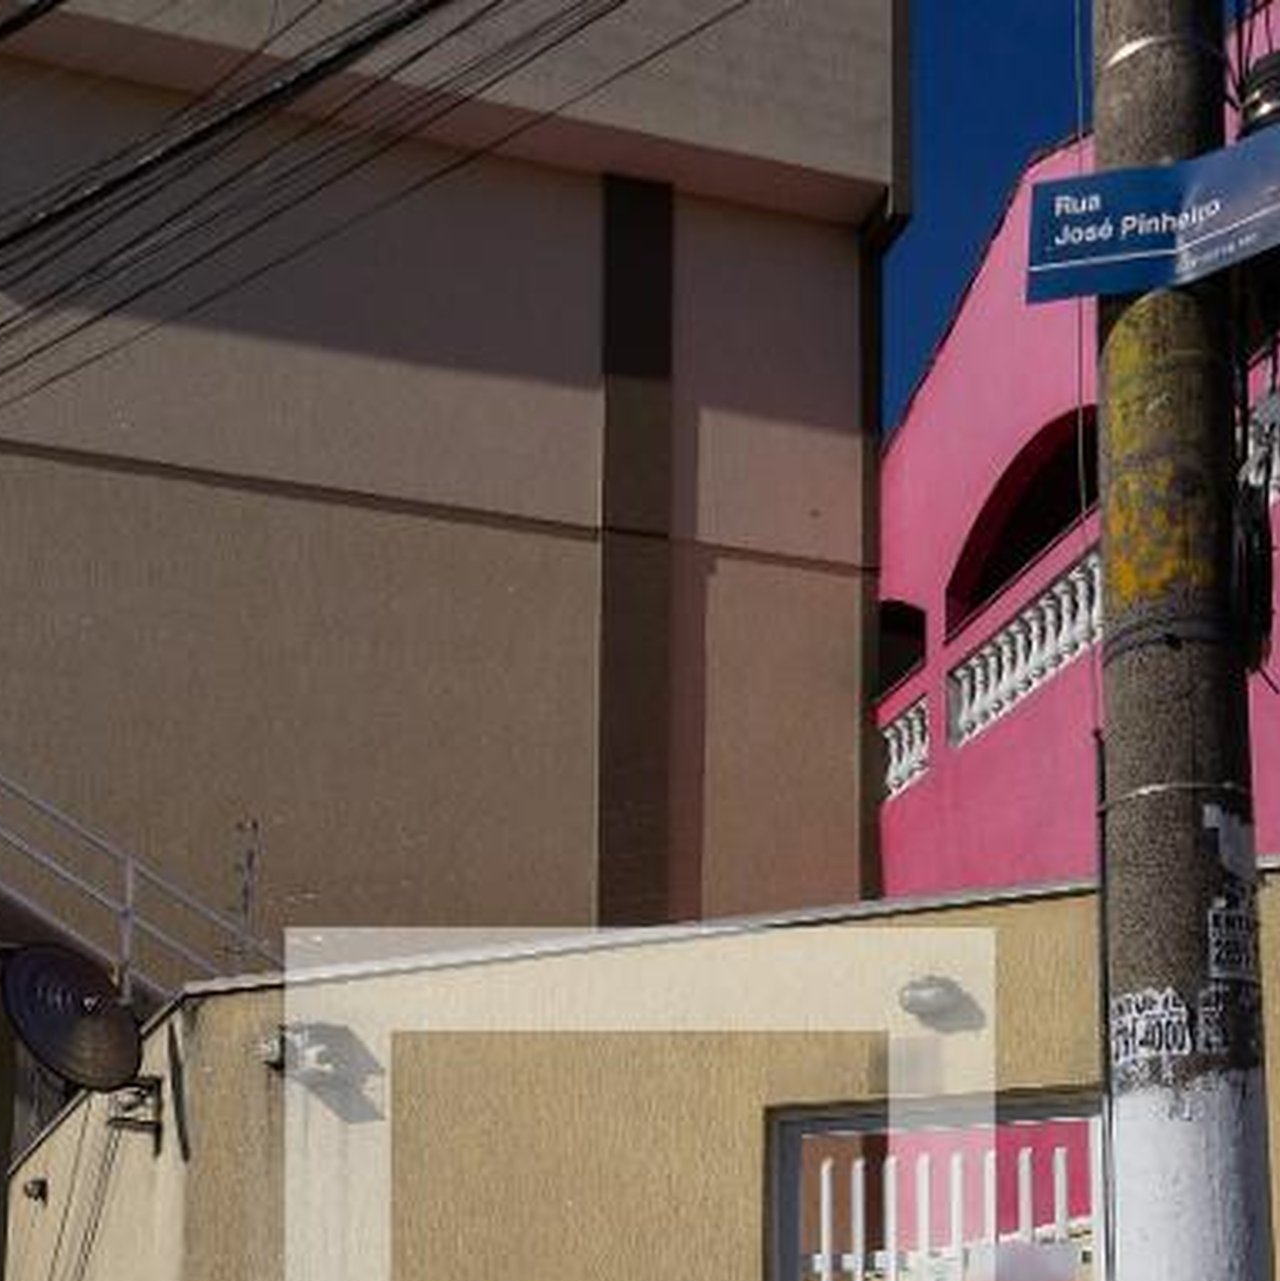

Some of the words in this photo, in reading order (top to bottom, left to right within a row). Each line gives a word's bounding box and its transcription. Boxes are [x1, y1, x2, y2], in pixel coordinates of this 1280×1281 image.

[1054, 194, 1101, 217] Rua
[1054, 217, 1113, 246] José
[1121, 199, 1221, 238] Pinheiro
